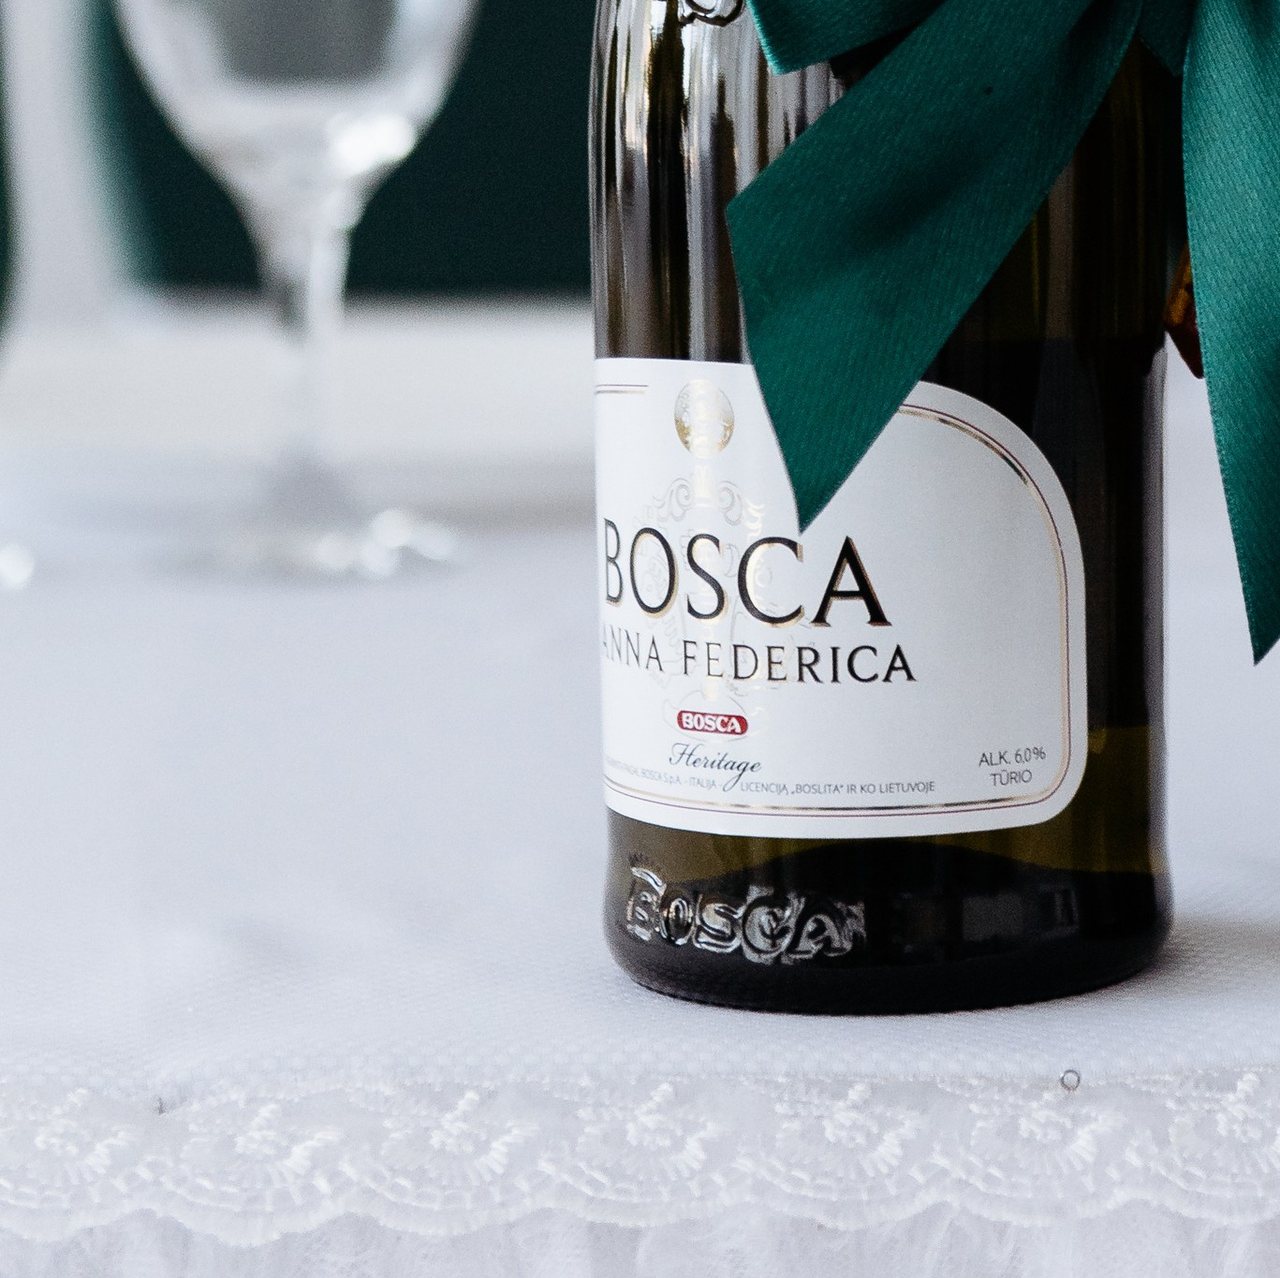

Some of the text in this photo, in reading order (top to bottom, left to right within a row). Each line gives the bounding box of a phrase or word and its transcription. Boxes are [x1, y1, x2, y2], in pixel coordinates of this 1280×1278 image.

[604, 518, 891, 627] BOSCA
[682, 639, 918, 684] FEDERICA
[681, 712, 743, 734] BOSCA
[668, 742, 763, 792] Heritage
[979, 750, 1011, 767] ALK.
[847, 784, 857, 794] IR
[860, 783, 877, 794] KO
[879, 781, 935, 793] LIETUVOJE
